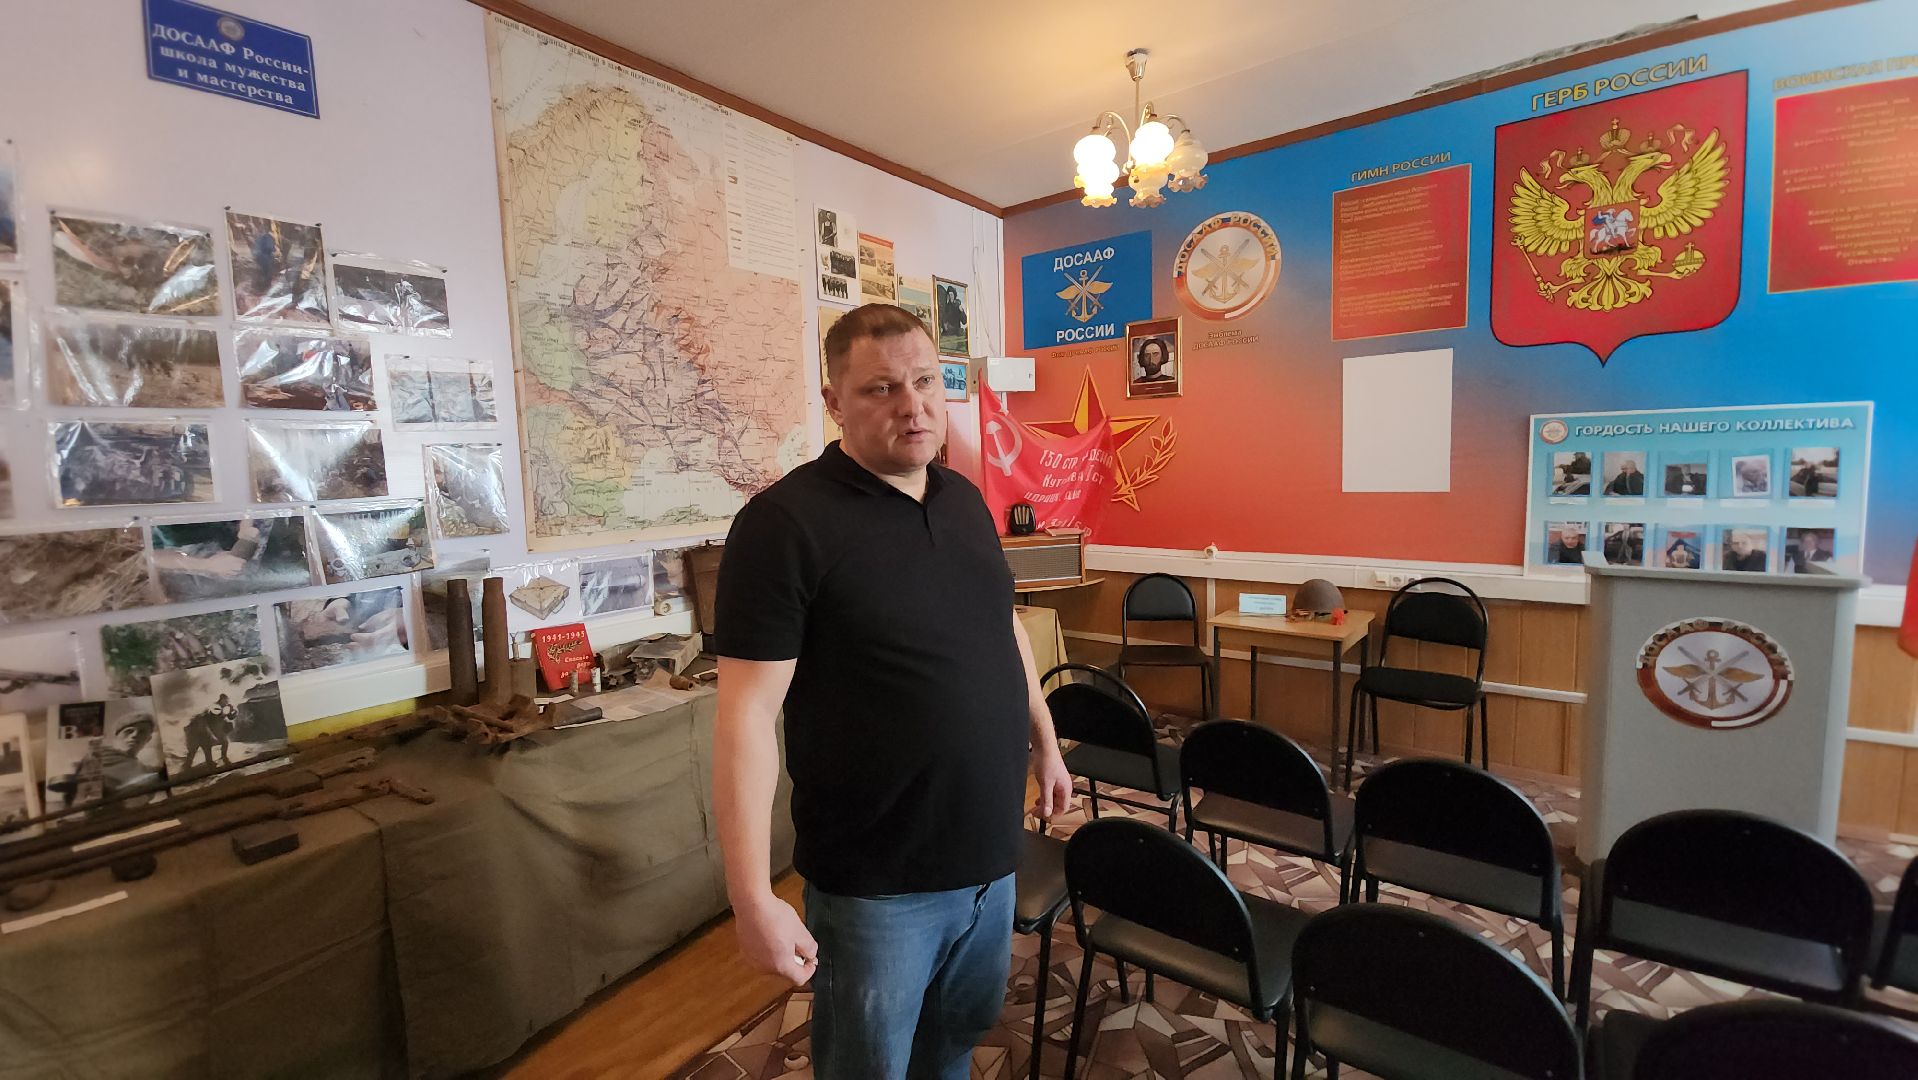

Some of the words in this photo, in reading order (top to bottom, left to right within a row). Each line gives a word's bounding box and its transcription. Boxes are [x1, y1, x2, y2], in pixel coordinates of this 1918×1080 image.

[152, 23, 236, 56] ДОСААФ
[160, 46, 219, 69] школа
[225, 62, 307, 92] мужества
[1532, 83, 1588, 111] ГЕРБ
[1594, 54, 1708, 96] РОССИИ
[177, 68, 189, 79] и
[196, 73, 294, 105] мастерства
[1351, 166, 1389, 182] ГИМН
[1392, 151, 1452, 173] РОССИИ
[1174, 217, 1222, 271] ДОСААФ
[1231, 212, 1280, 257] РОССИИ
[1053, 247, 1115, 272] ДОСААФ
[1056, 323, 1115, 342] РОССИИ
[1575, 423, 1653, 436] ГОРДОСТЬ
[1659, 420, 1730, 434] НАШЕГО
[1736, 416, 1855, 431] КОЛЛЕКТИВА
[1040, 450, 1062, 469] 150
[541, 631, 585, 643] 1941-1945
[1639, 619, 1709, 668] ДОСААФ
